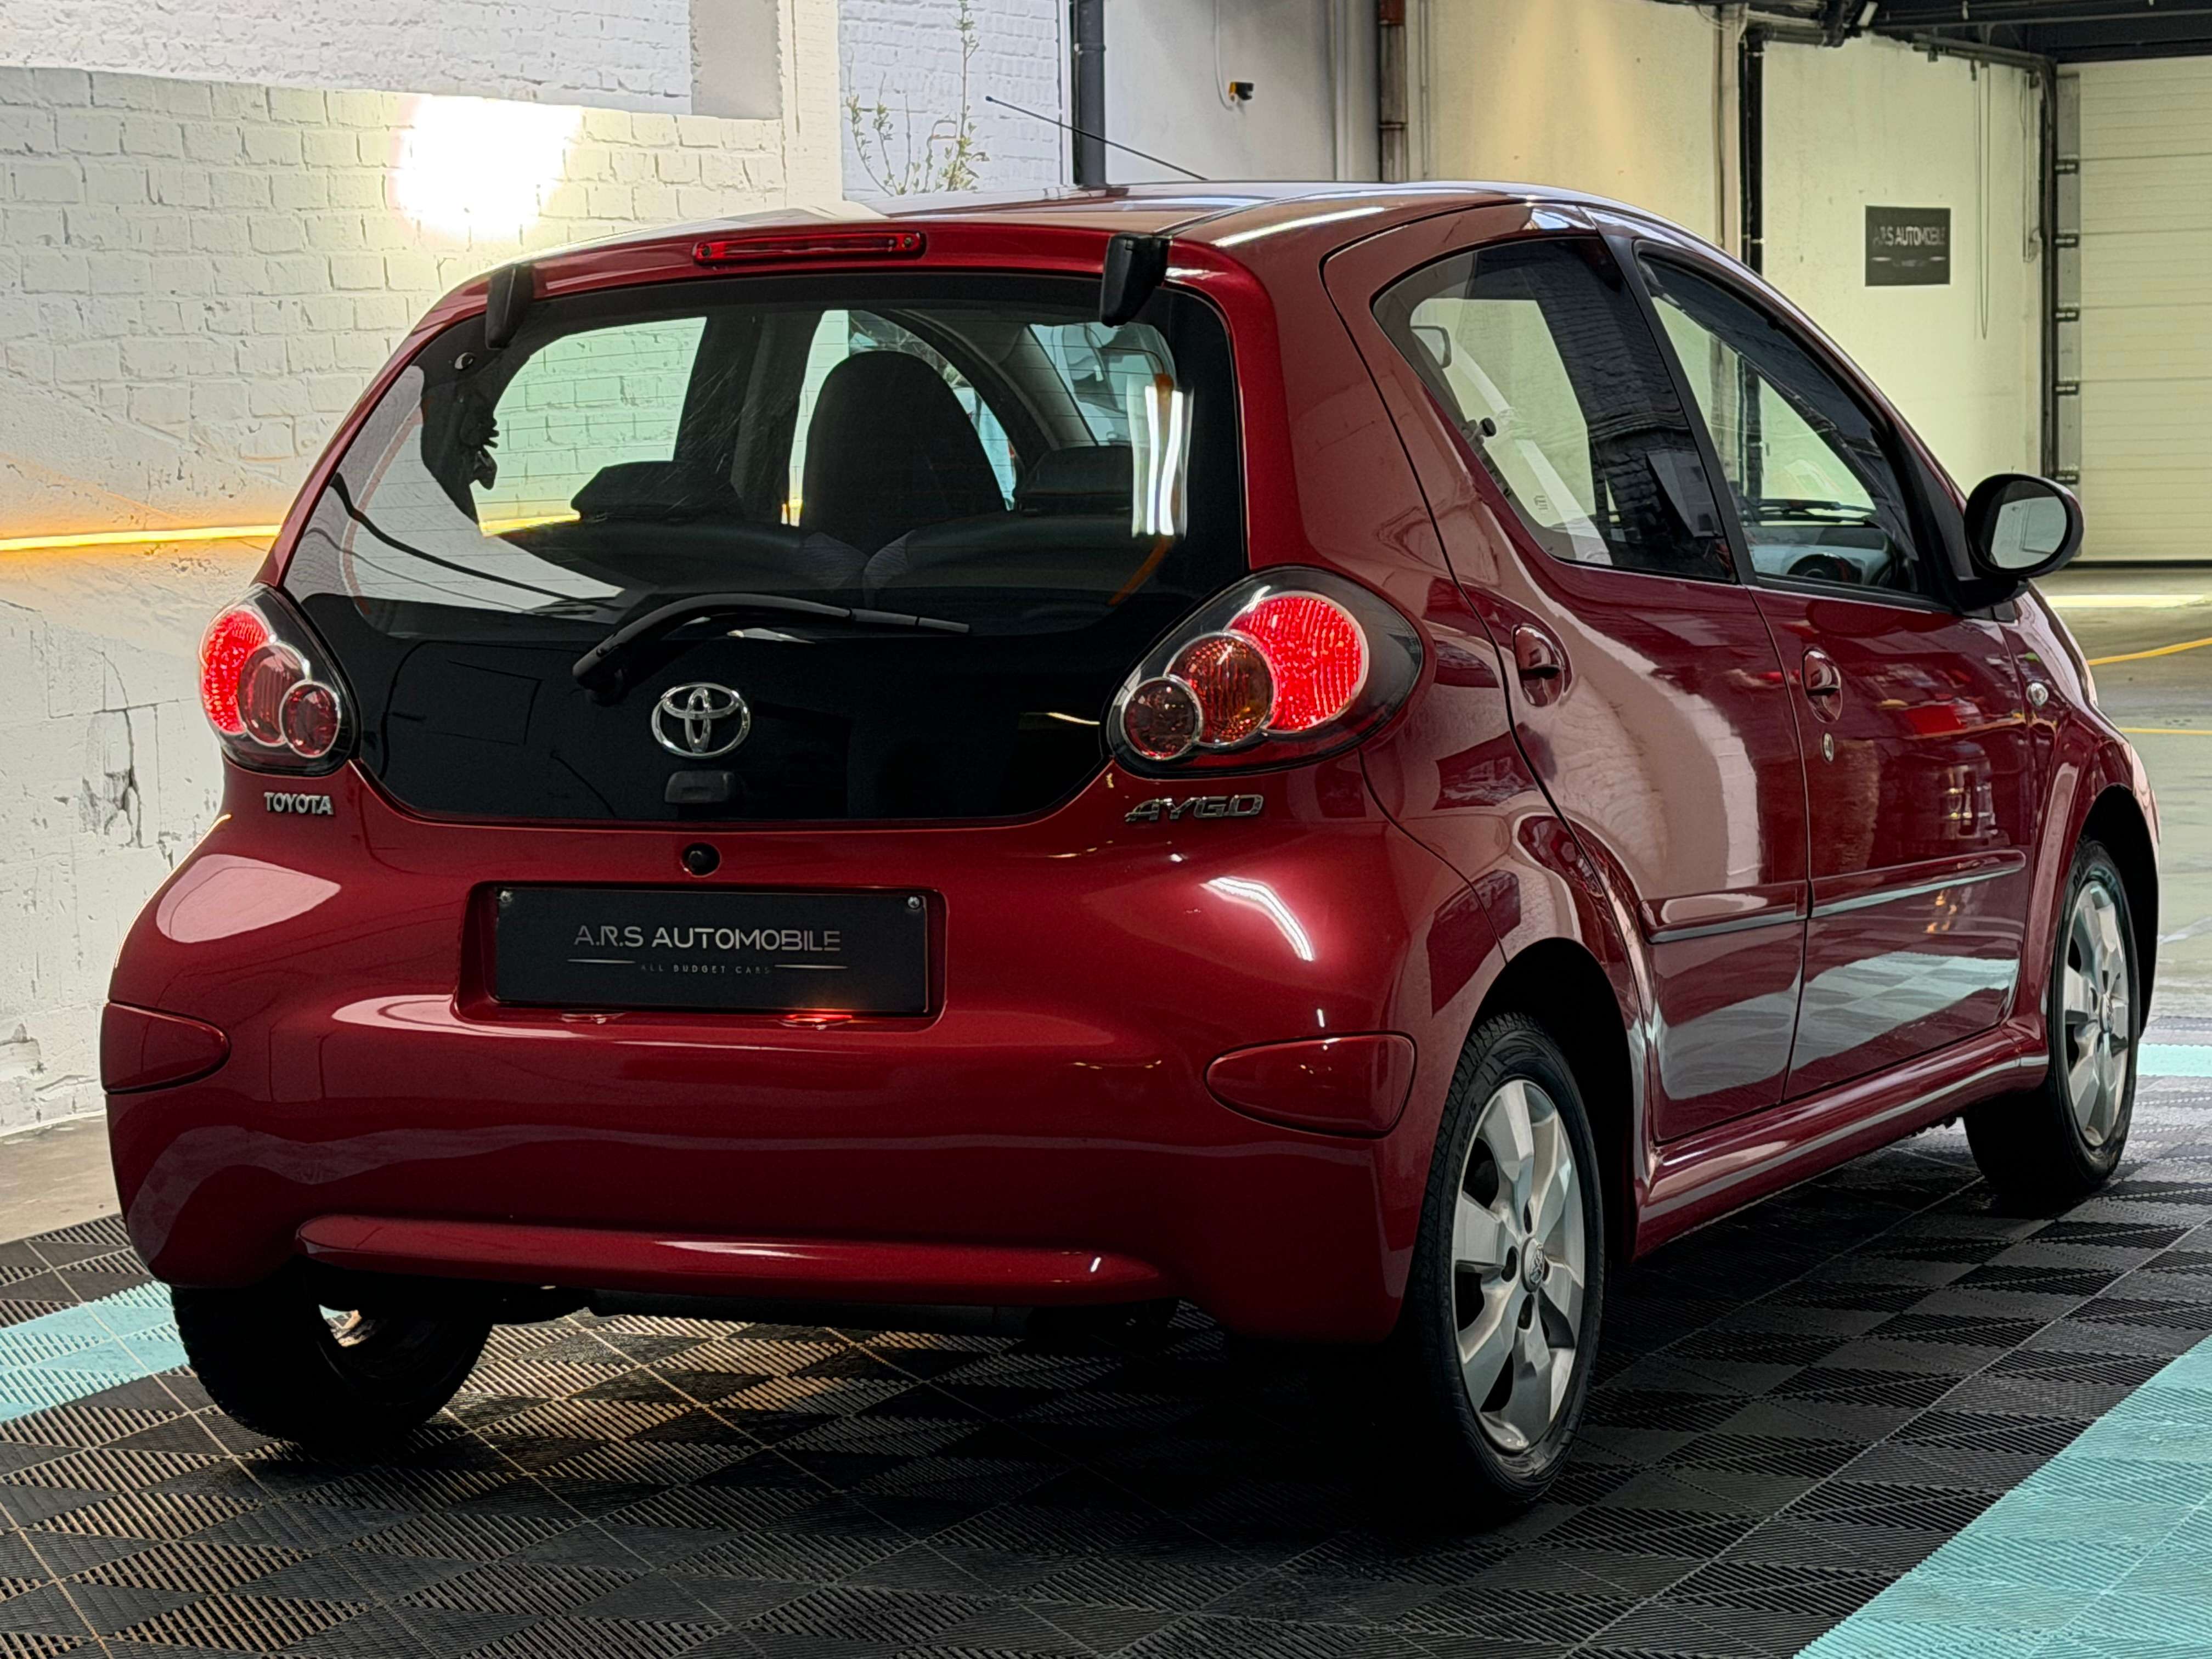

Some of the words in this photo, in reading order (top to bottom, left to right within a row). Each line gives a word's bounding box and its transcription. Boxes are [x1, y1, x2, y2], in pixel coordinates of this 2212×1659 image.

[263, 792, 334, 815] TOYOTA
[1124, 794, 1264, 822] AYGO
[574, 925, 644, 947] A.R.S
[651, 927, 841, 952] AUTOMOBILE
[640, 964, 664, 972] ALL
[673, 964, 726, 974] BUDGET
[735, 966, 771, 974] CARS
